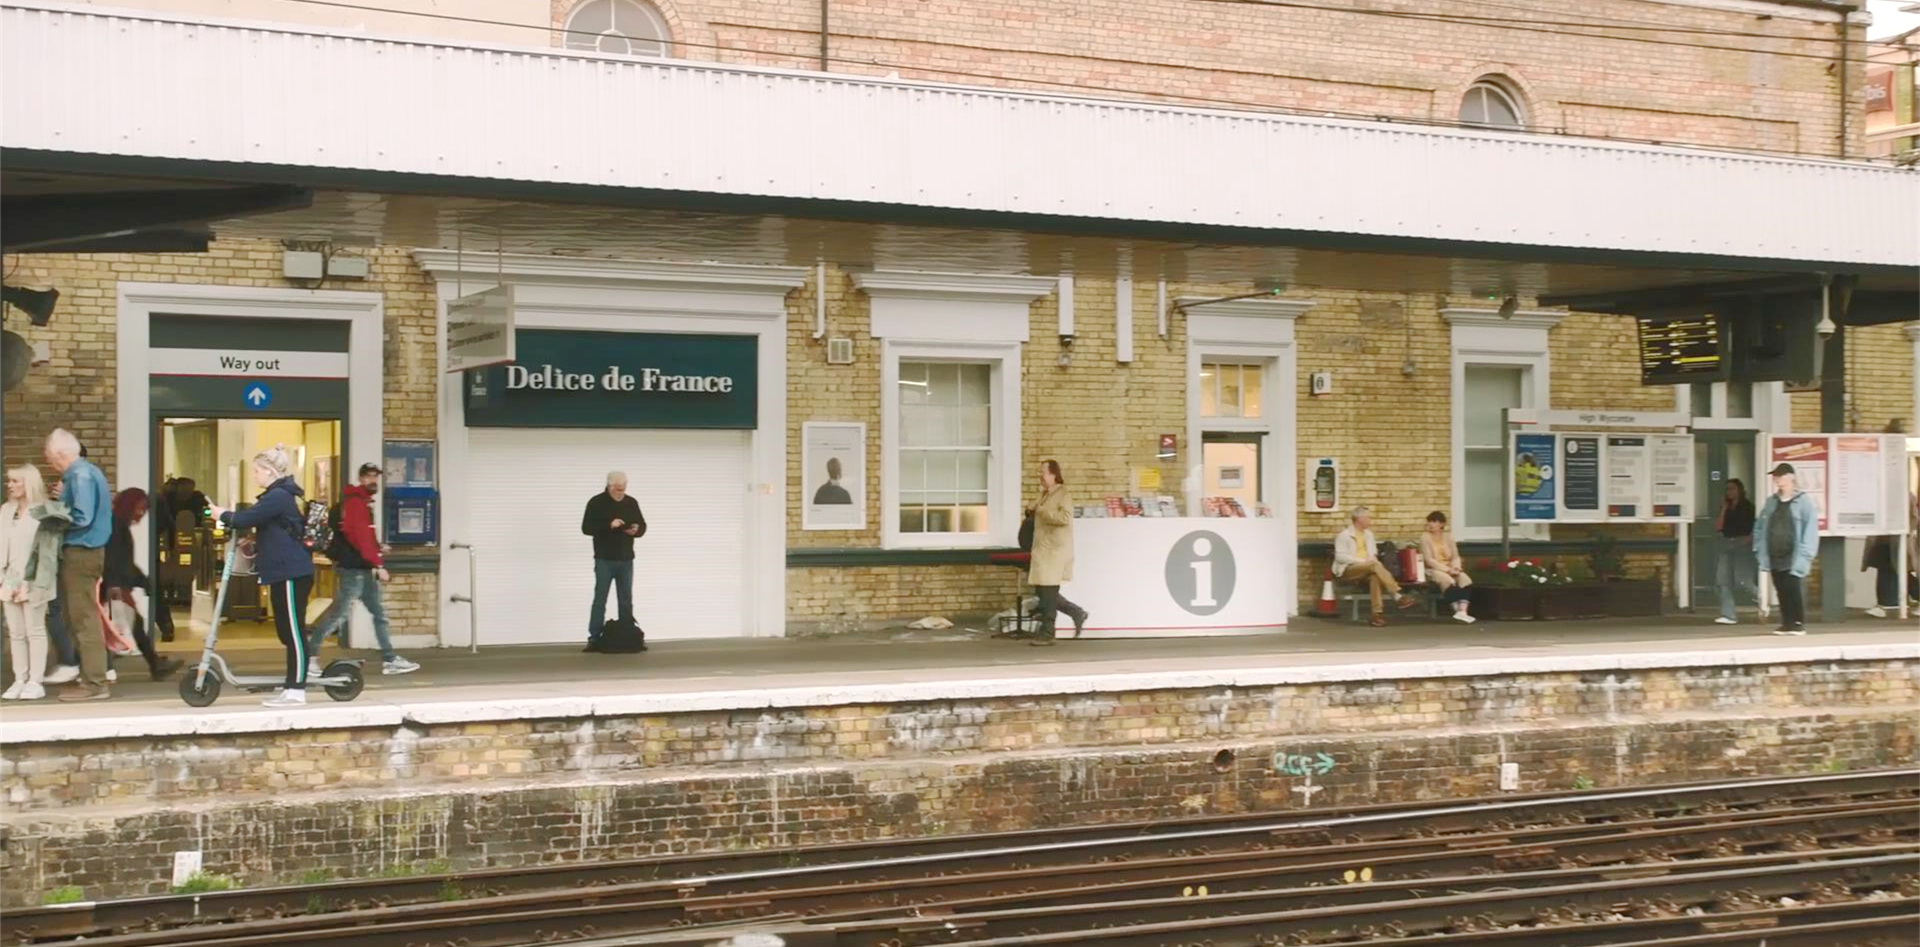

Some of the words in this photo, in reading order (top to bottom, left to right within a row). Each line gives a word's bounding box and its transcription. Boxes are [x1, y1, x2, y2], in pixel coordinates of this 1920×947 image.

[220, 356, 251, 372] Way
[255, 359, 280, 370] out
[505, 364, 595, 390] Delice
[602, 366, 635, 391] de
[641, 368, 733, 393] France
